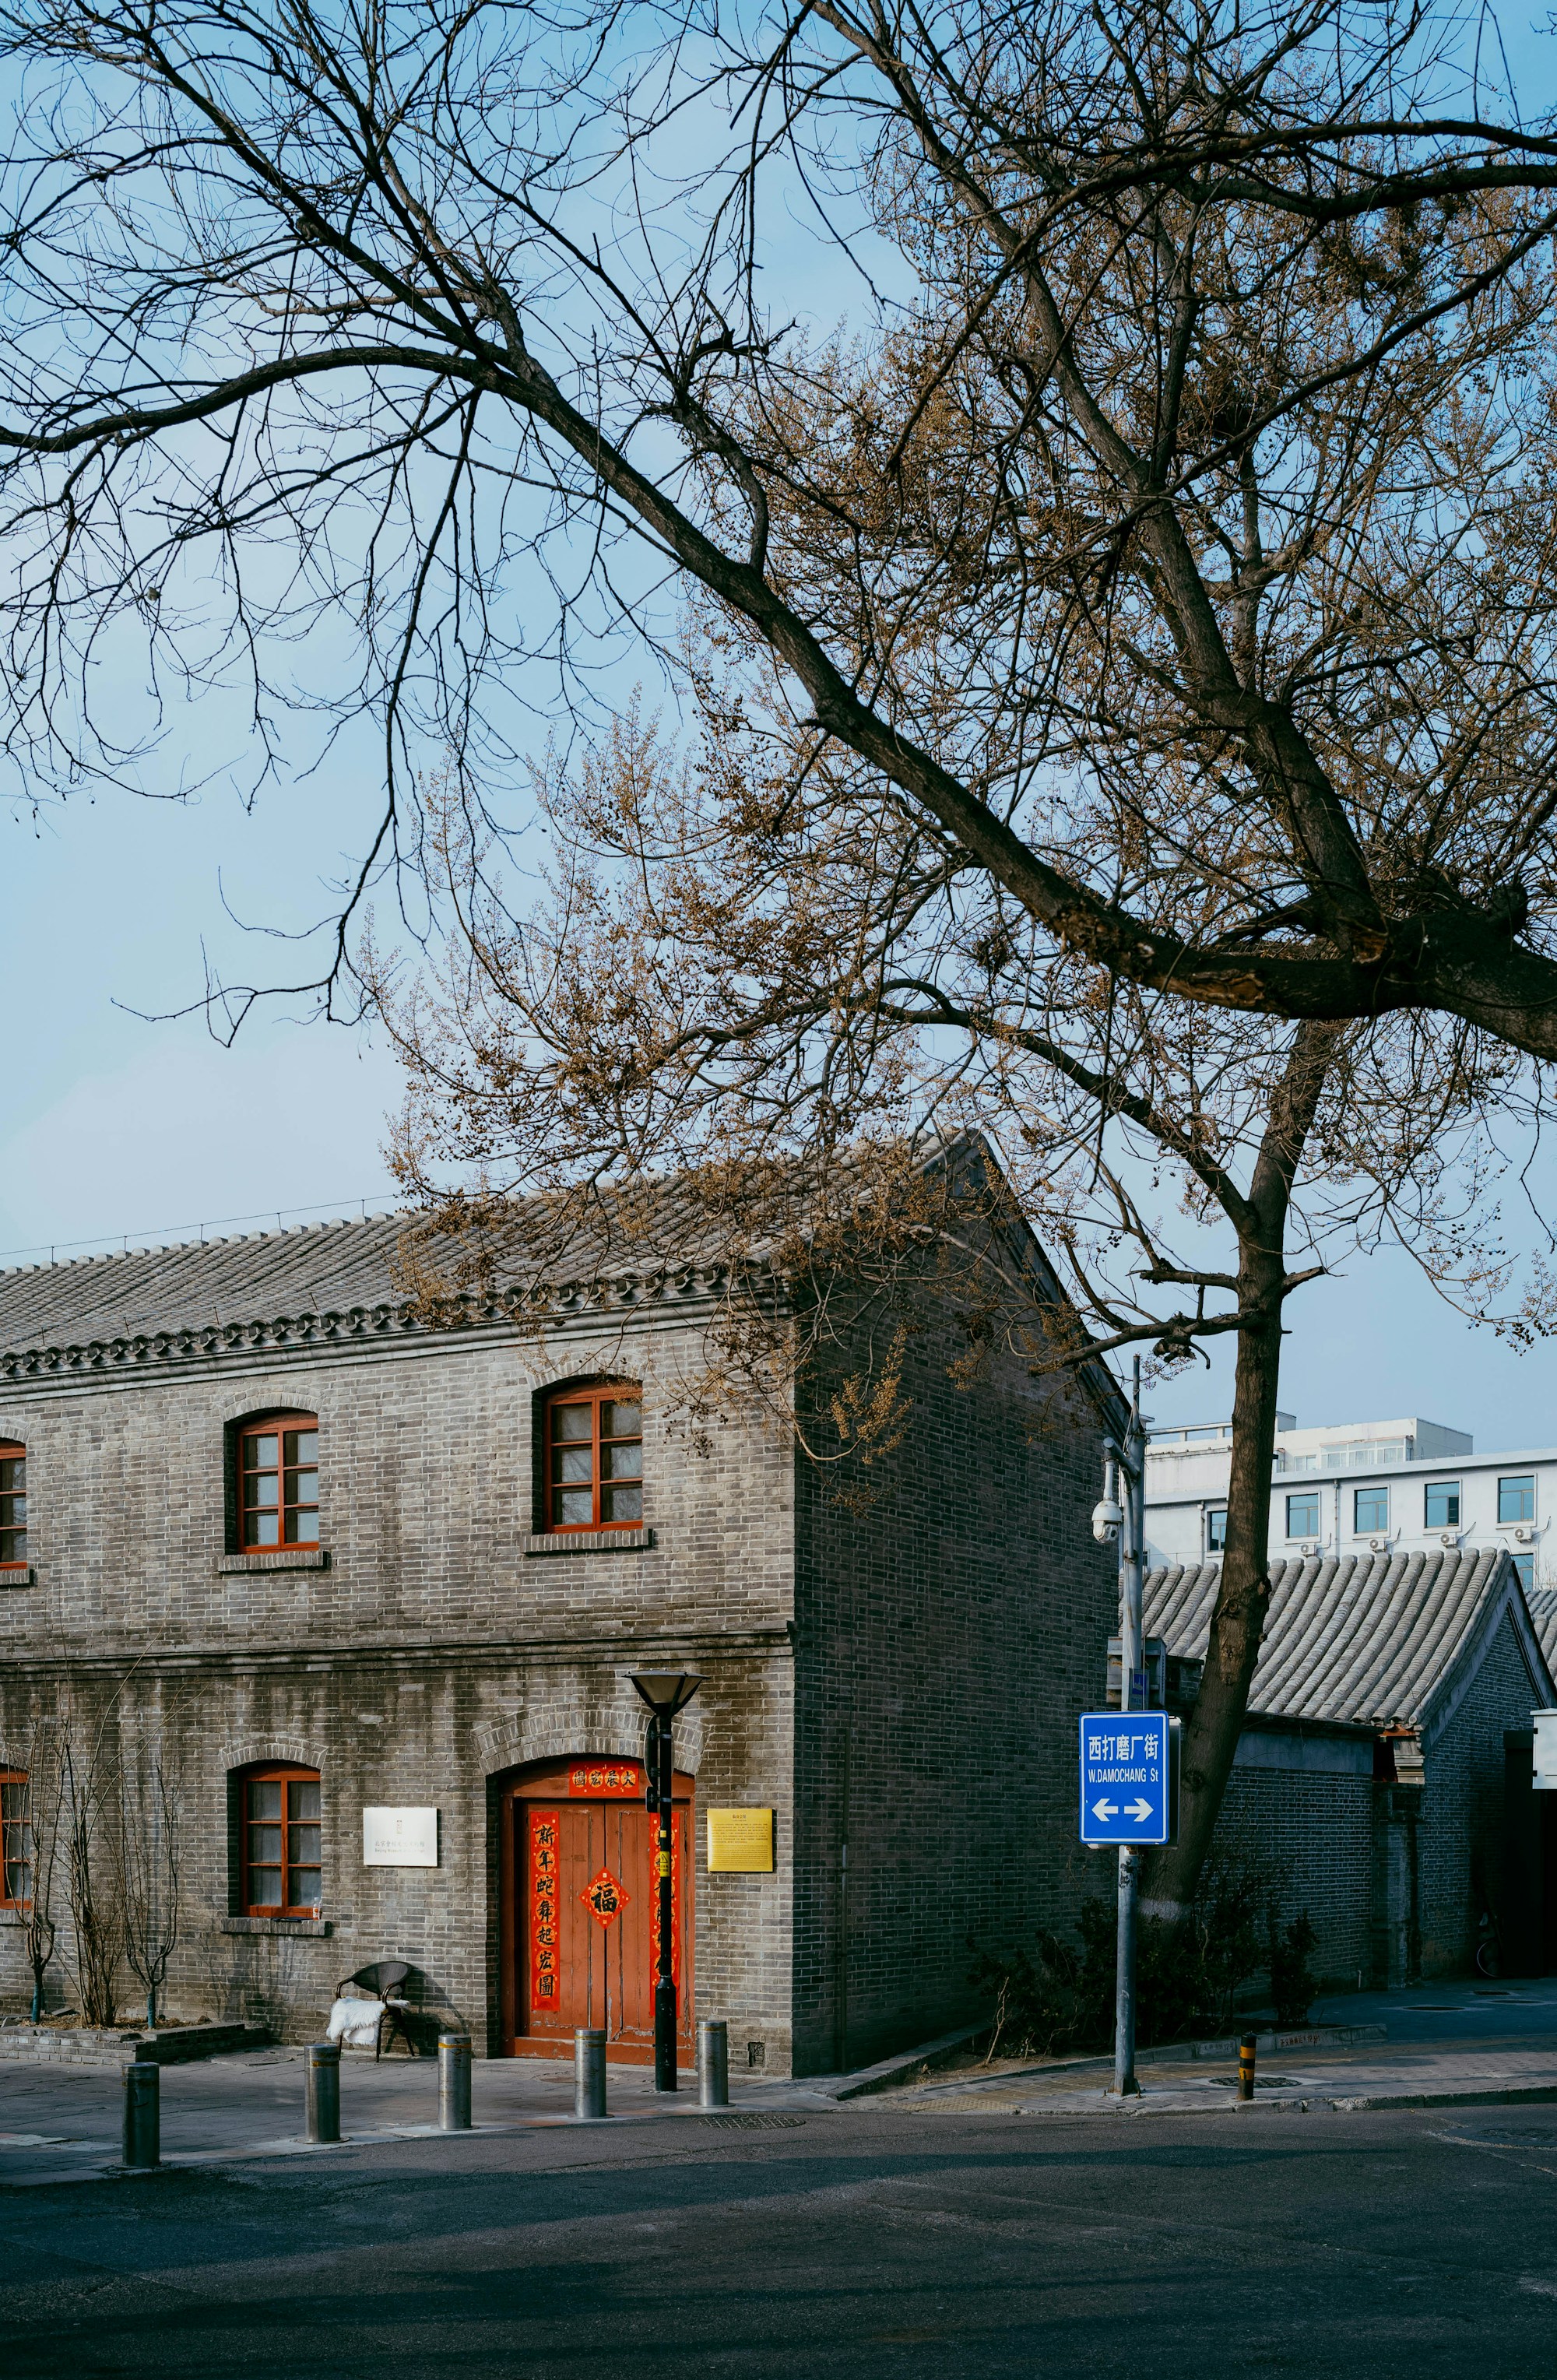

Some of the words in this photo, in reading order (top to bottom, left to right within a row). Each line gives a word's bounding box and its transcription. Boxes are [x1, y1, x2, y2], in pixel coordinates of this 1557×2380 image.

[1088, 1733, 1158, 1761] 西打磨厂街
[1088, 1768, 1146, 1783] W.DAMOCHANG
[1150, 1767, 1158, 1782] St
[535, 1824, 555, 1998] 新年蛇舞起宏圖
[590, 1883, 618, 1914] 福
